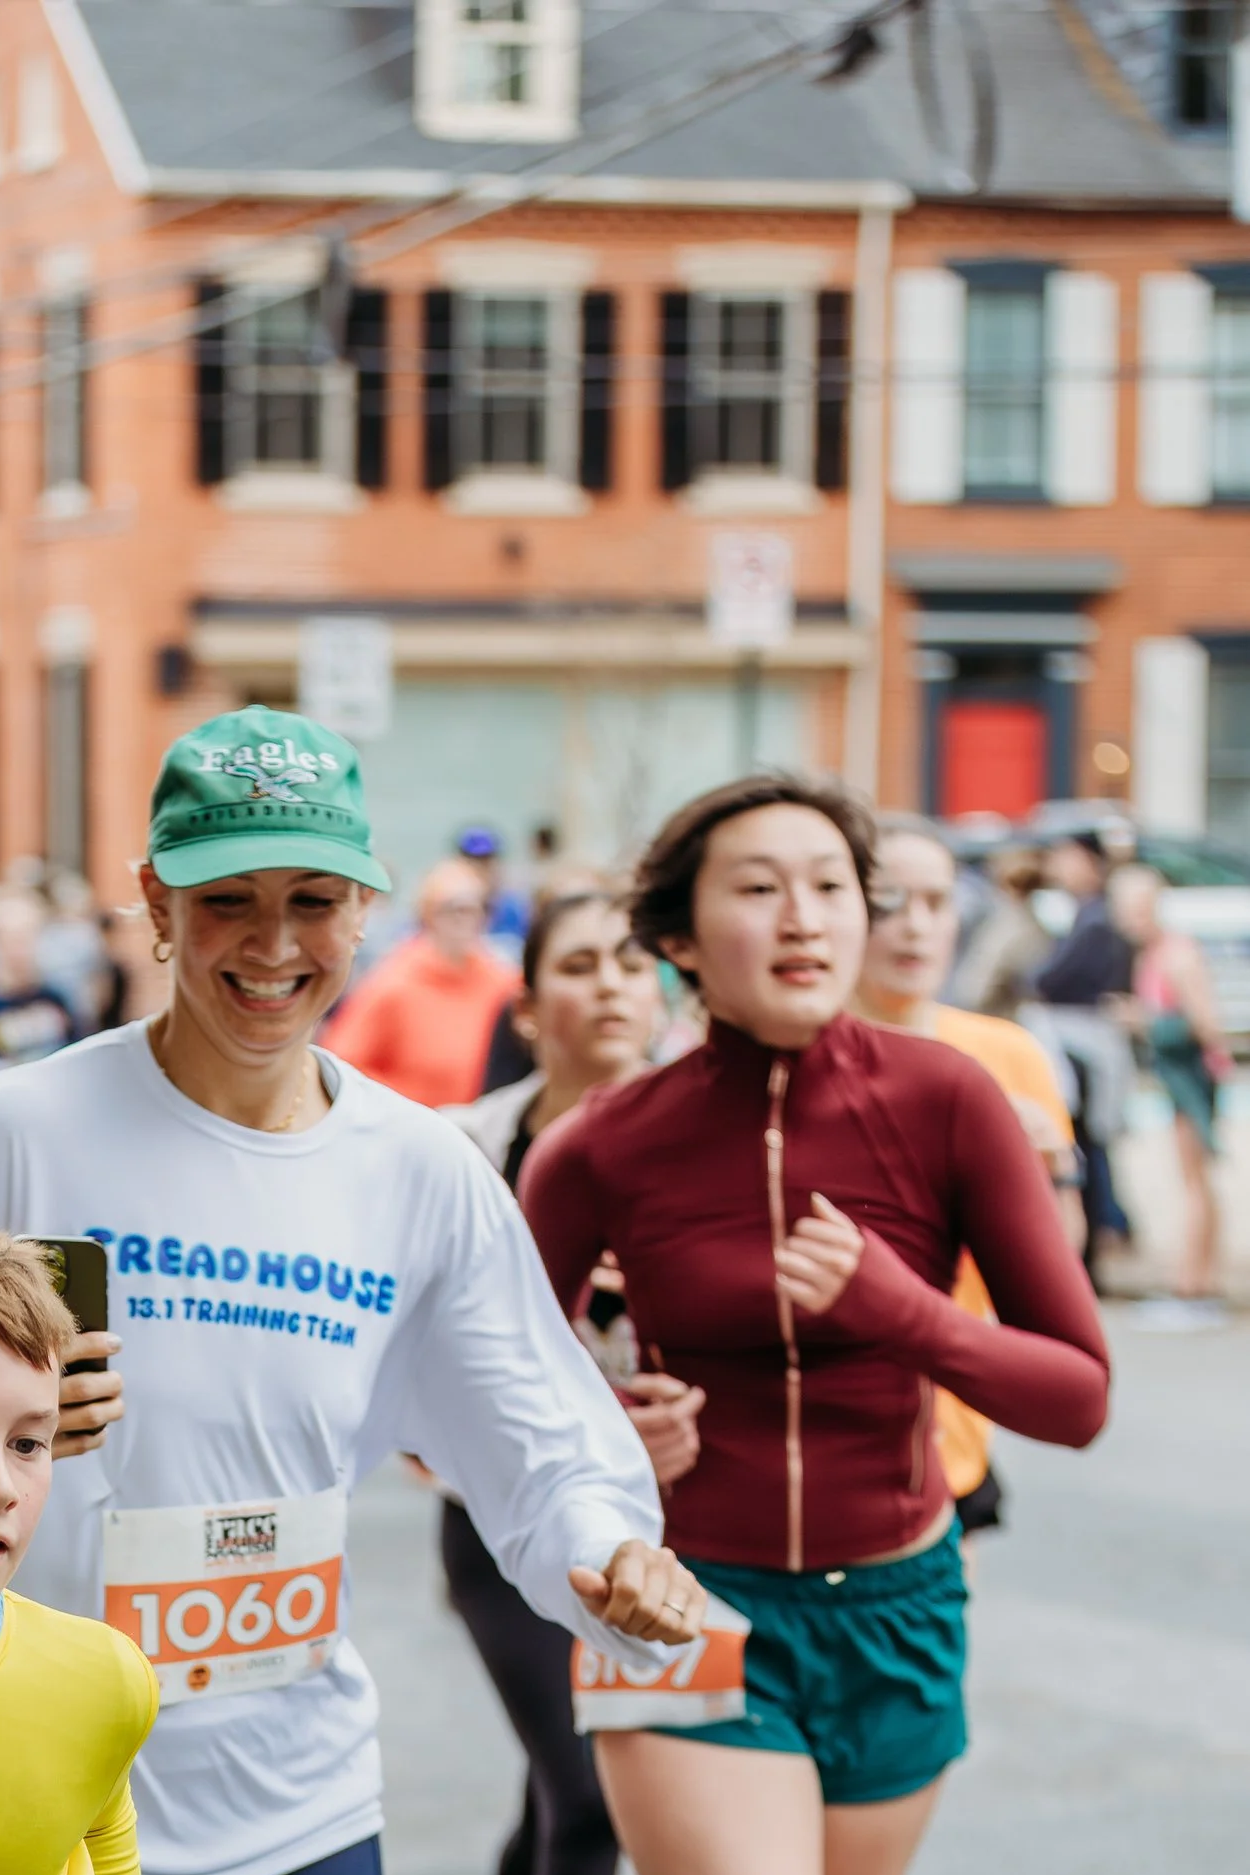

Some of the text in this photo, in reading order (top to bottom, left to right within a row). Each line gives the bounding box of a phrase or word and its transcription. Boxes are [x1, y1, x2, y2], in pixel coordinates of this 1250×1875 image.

[198, 738, 339, 772] Eagles
[127, 1297, 173, 1319] 13.1
[182, 1298, 300, 1335] TRAINING
[131, 1573, 327, 1657] 1060
